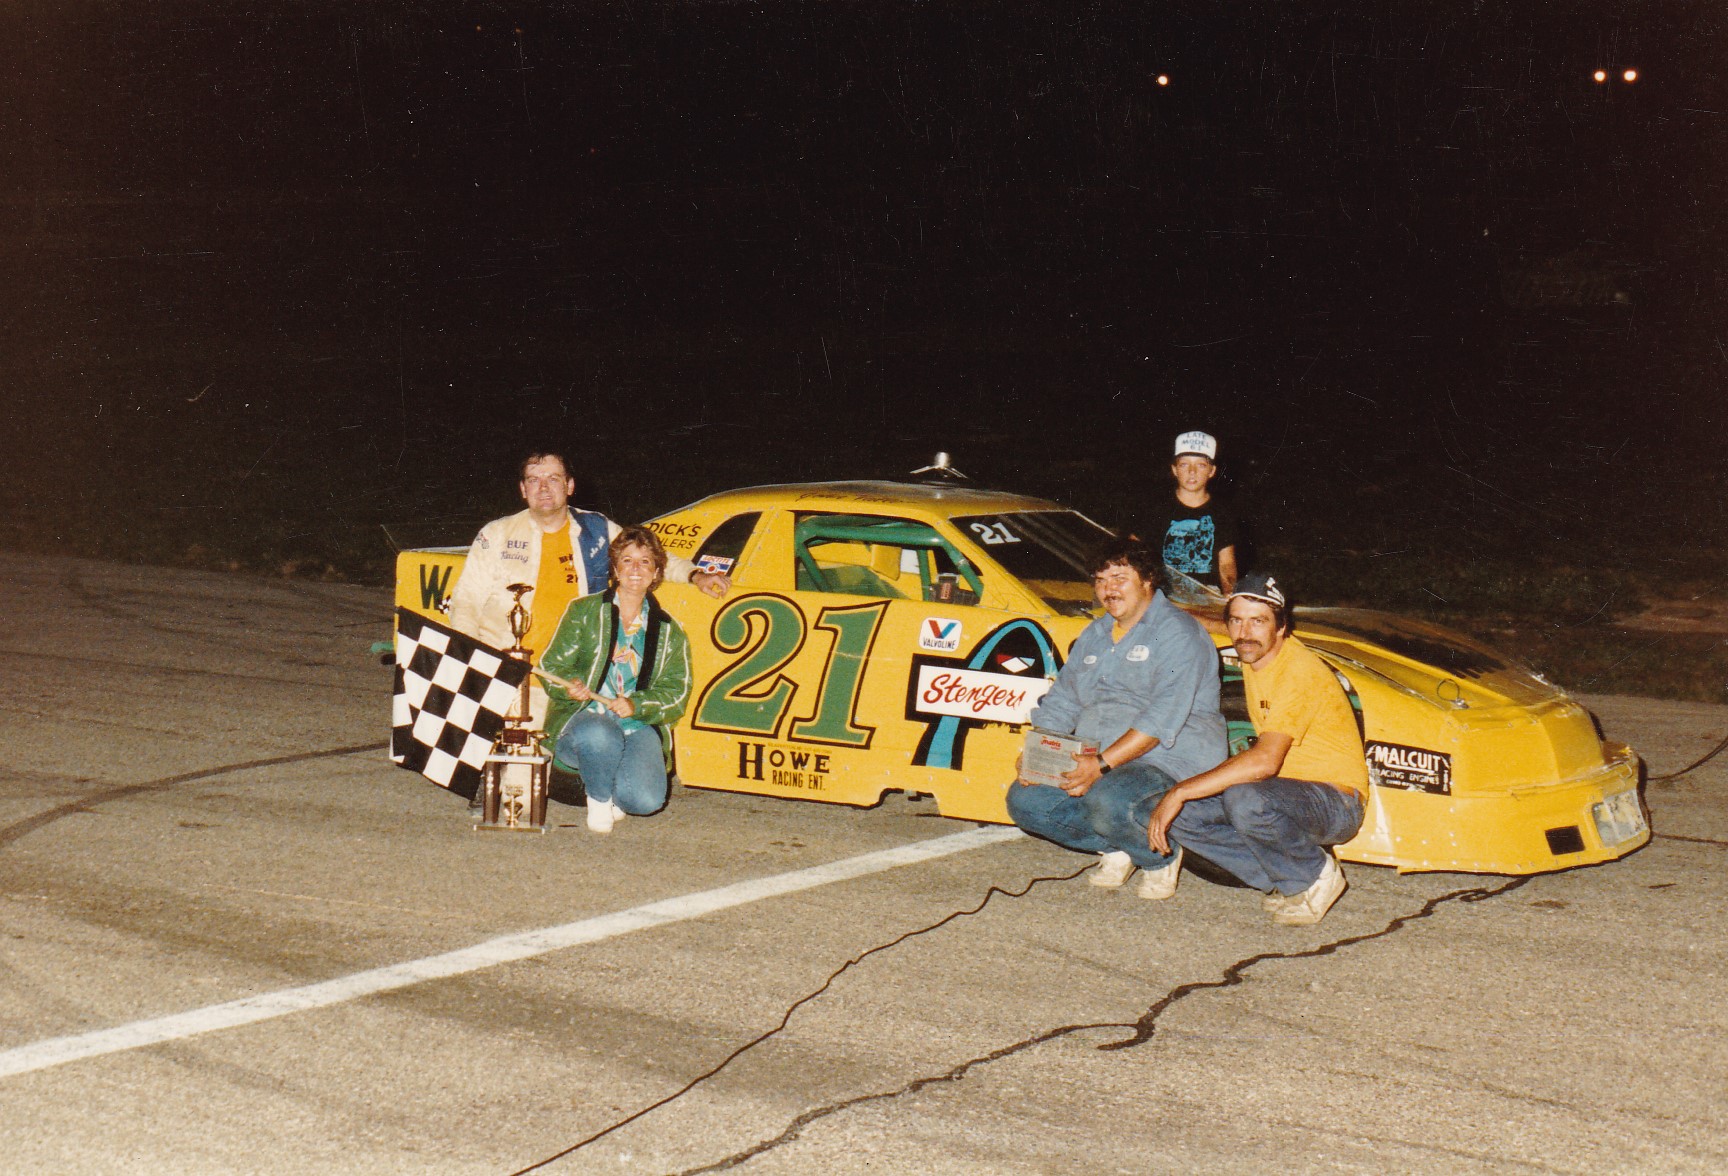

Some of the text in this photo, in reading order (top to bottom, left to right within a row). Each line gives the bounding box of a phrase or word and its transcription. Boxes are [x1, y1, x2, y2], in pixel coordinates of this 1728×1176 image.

[970, 522, 1021, 544] 21
[922, 637, 956, 650] VALVOLINE
[691, 592, 893, 750] 21
[737, 741, 831, 782] HOWE
[1374, 745, 1441, 773] MALCUIT
[772, 769, 826, 791] RACING ENT.
[1409, 773, 1440, 785] ENGINES
